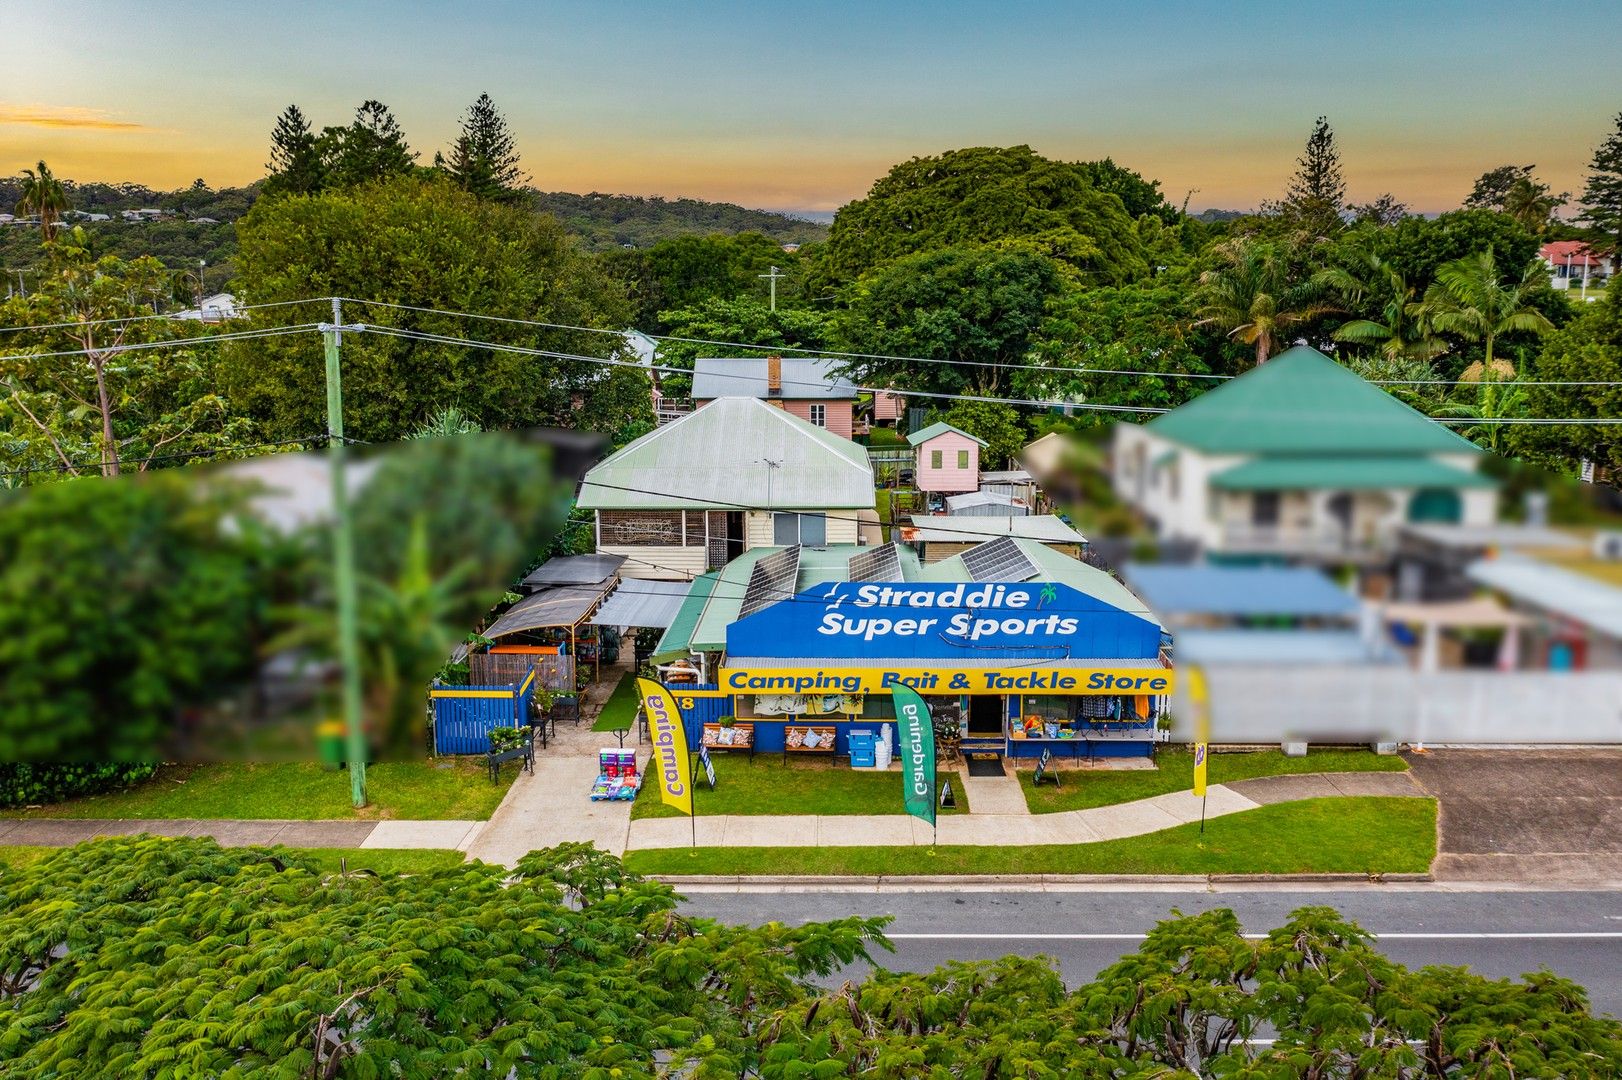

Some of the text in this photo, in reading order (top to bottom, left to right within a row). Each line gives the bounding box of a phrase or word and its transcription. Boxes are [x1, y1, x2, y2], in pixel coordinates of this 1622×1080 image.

[853, 584, 1030, 608] Straddie
[817, 613, 1080, 641] Super Sports
[729, 671, 1168, 694] Camping, Bait & Tackle Store
